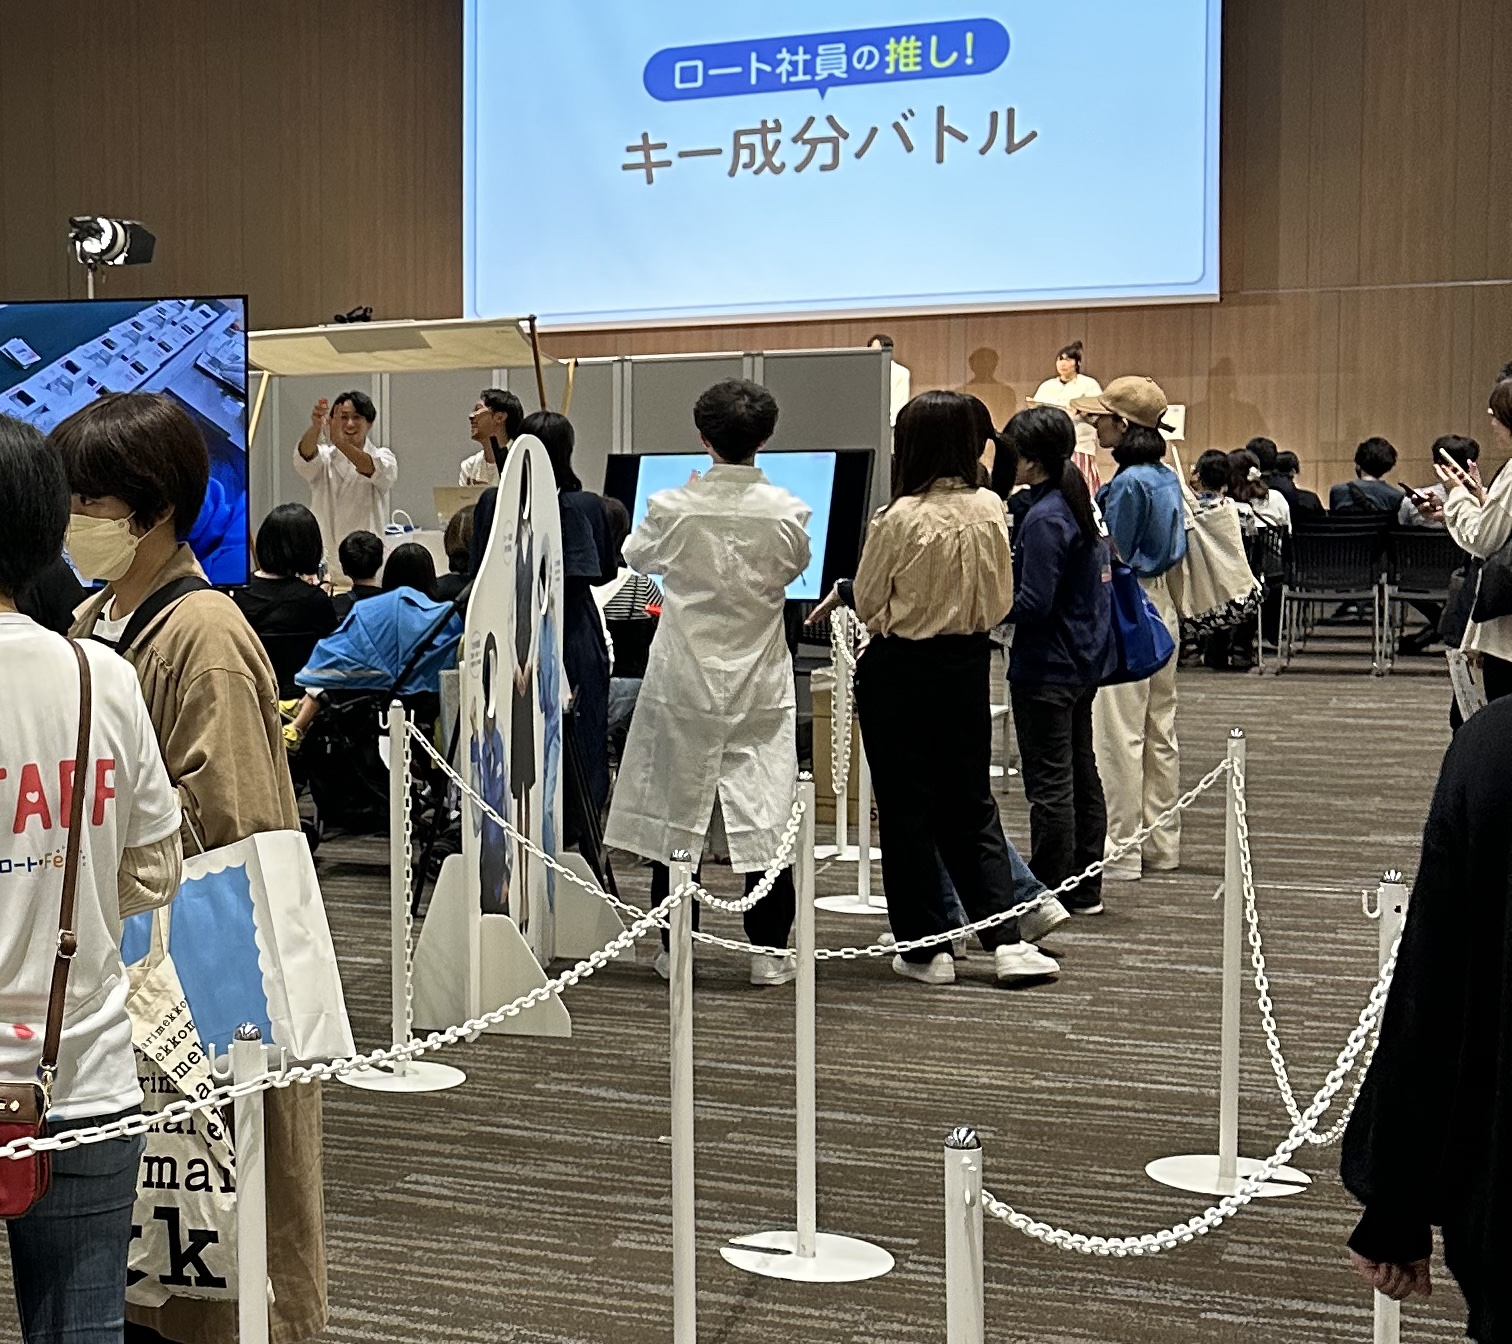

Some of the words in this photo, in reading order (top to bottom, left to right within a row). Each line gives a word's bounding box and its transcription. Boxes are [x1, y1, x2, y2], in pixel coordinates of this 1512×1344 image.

[674, 32, 975, 90] ロート社員の推し!
[621, 105, 1038, 185] キー成分バトル
